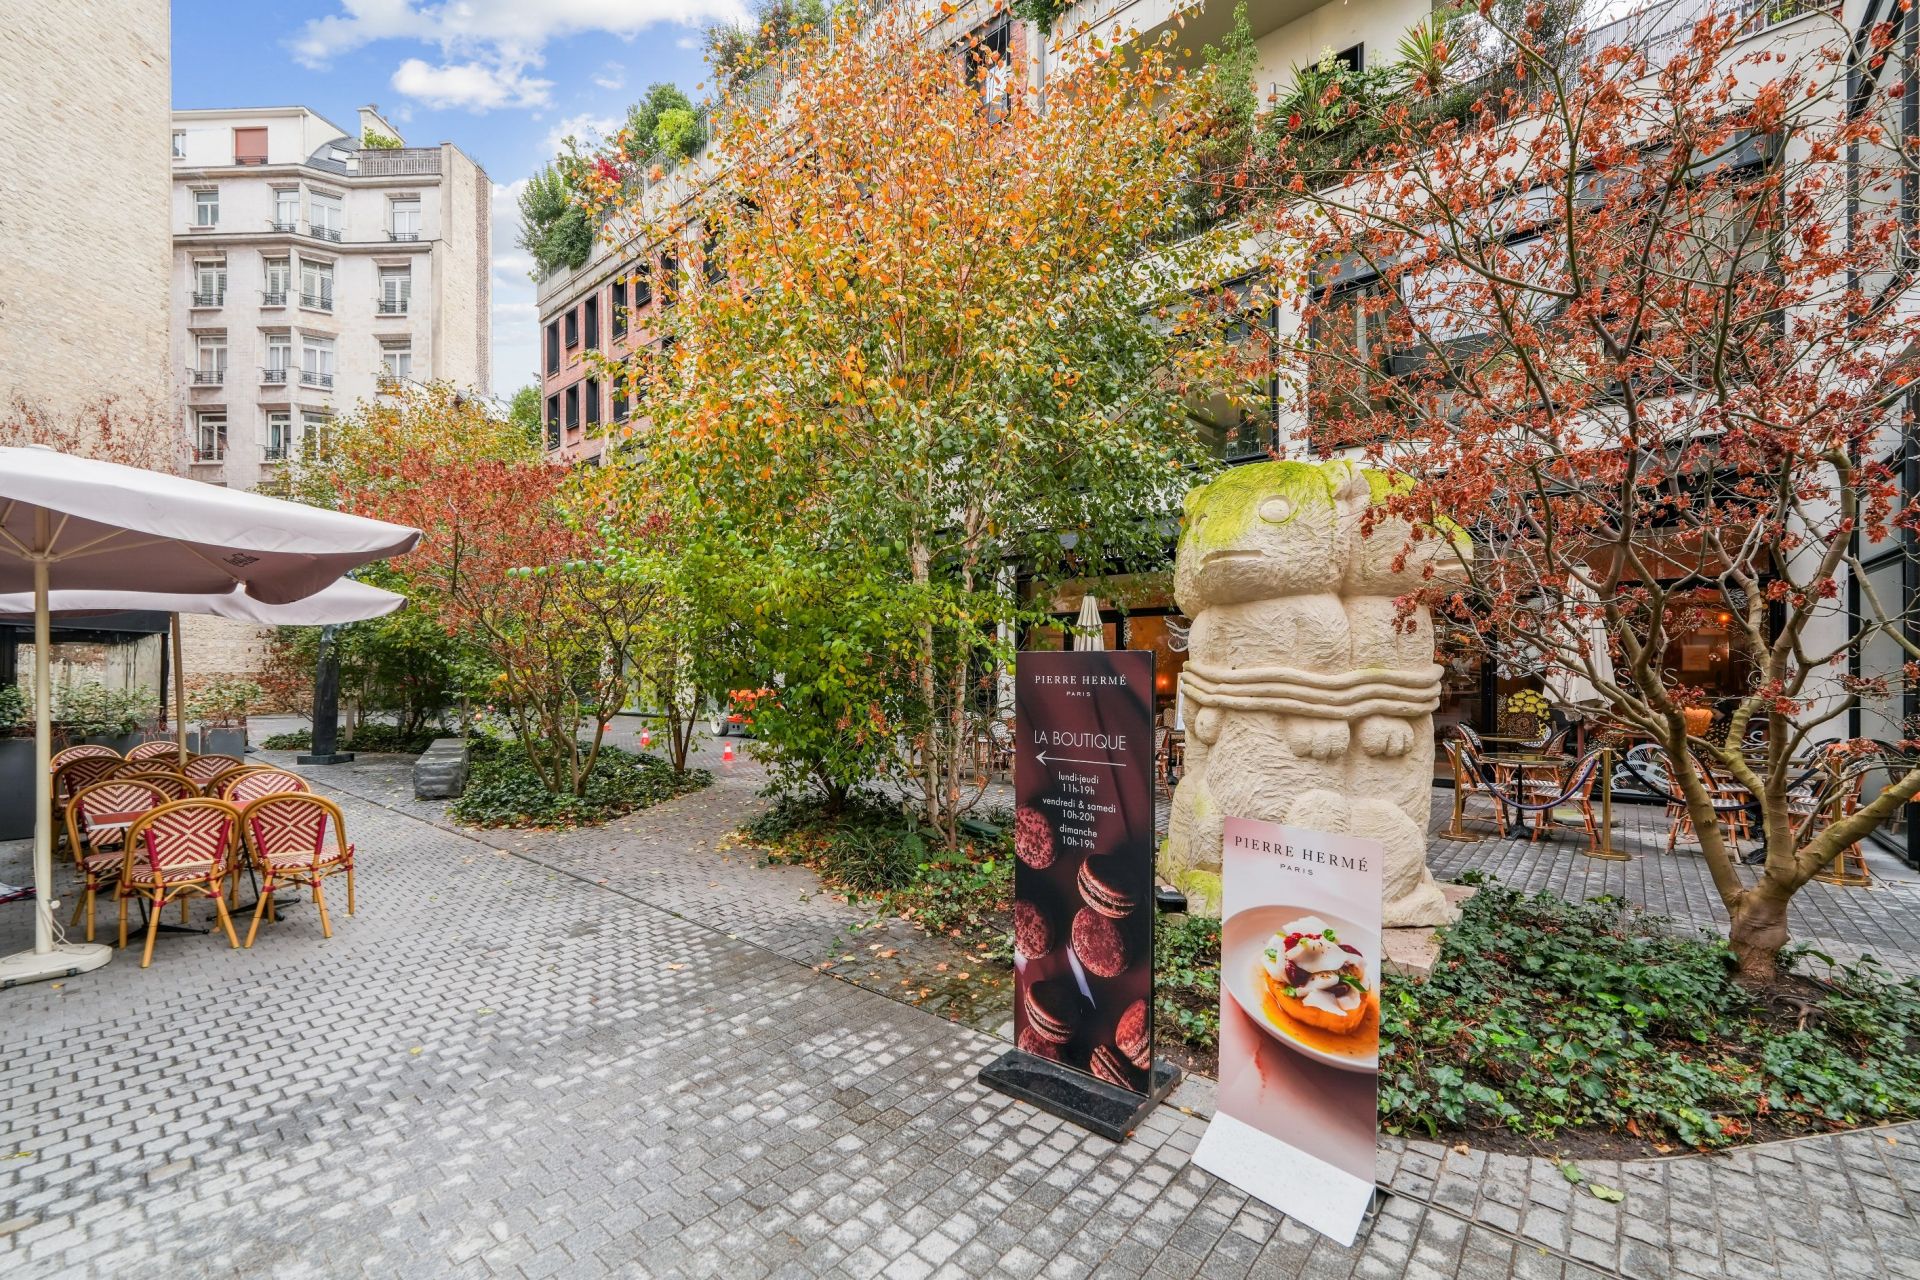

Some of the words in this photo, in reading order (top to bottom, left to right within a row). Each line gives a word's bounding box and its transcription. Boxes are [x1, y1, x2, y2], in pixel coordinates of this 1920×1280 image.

[1035, 675, 1077, 684] PIERRE
[1082, 673, 1127, 686] HERMÉ
[1034, 729, 1049, 745] LA
[1052, 731, 1127, 751] BOUTIQUE
[1058, 770, 1099, 785] lundi-jeudi
[1063, 783, 1095, 795] 11h-19h
[1042, 797, 1076, 808] vendredi
[1078, 800, 1085, 810] &
[1087, 803, 1116, 813] samedi
[1063, 809, 1095, 822] 10h-20h
[1059, 823, 1098, 838] dimanche
[1063, 836, 1095, 850] 10h-19h
[1234, 835, 1294, 858] PIERRE
[1302, 848, 1369, 873] HERMÉ
[1279, 863, 1314, 876] PARIS
